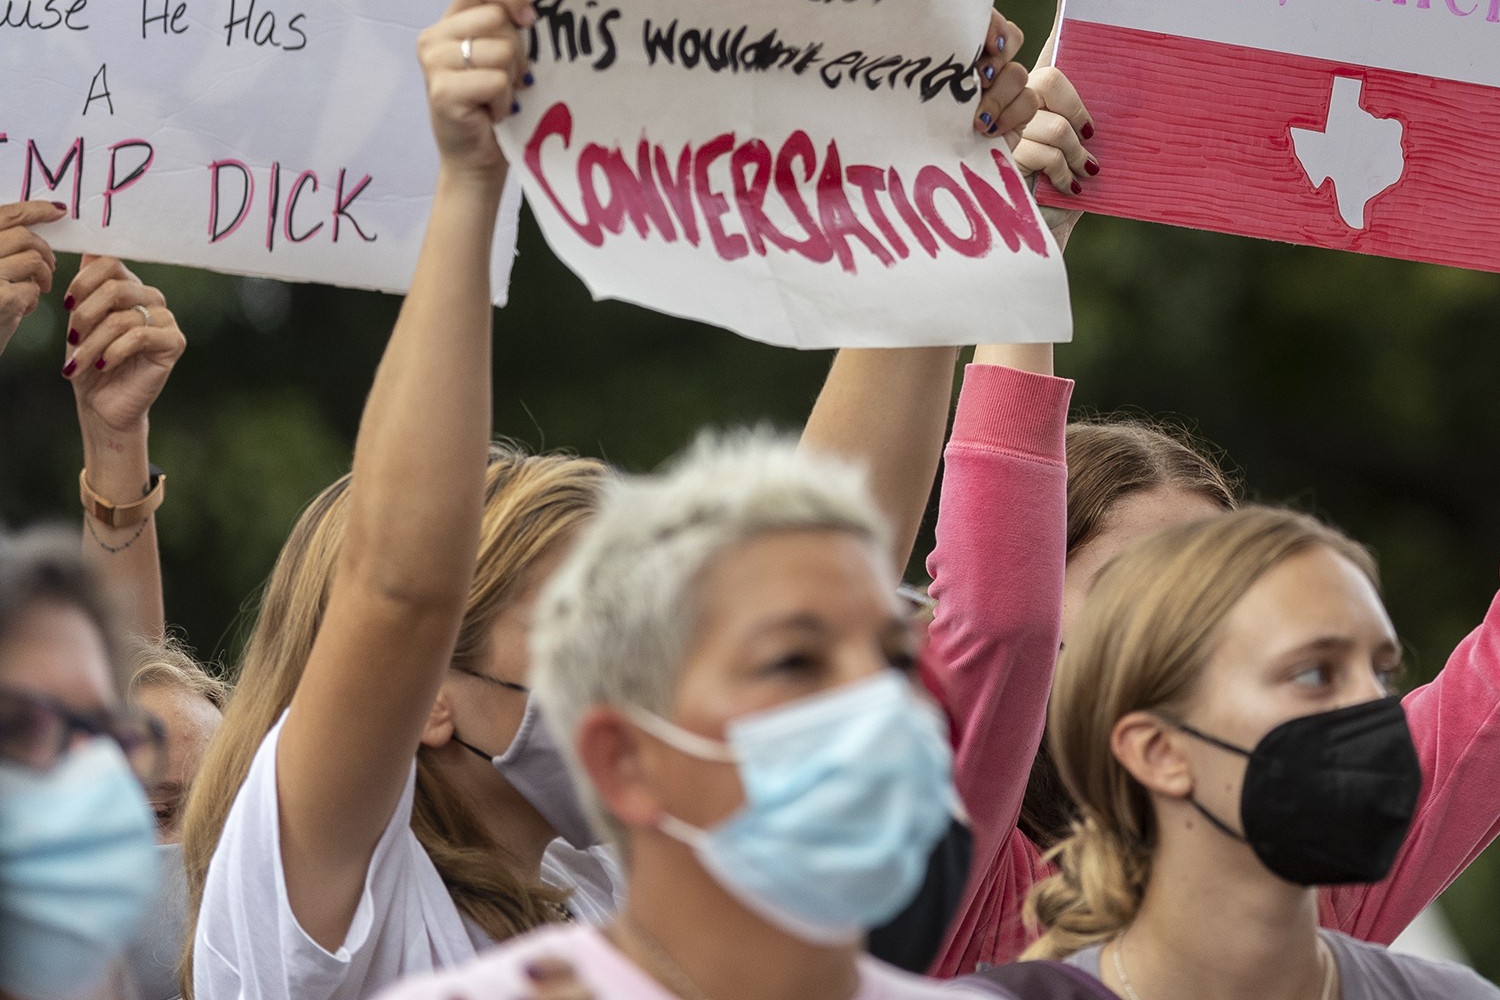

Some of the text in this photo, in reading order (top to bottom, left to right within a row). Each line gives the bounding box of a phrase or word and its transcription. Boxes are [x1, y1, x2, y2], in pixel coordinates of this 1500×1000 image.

[82, 63, 114, 116] A
[0, 132, 377, 252] MP DICK
[523, 101, 1050, 275] CONVERSATION
